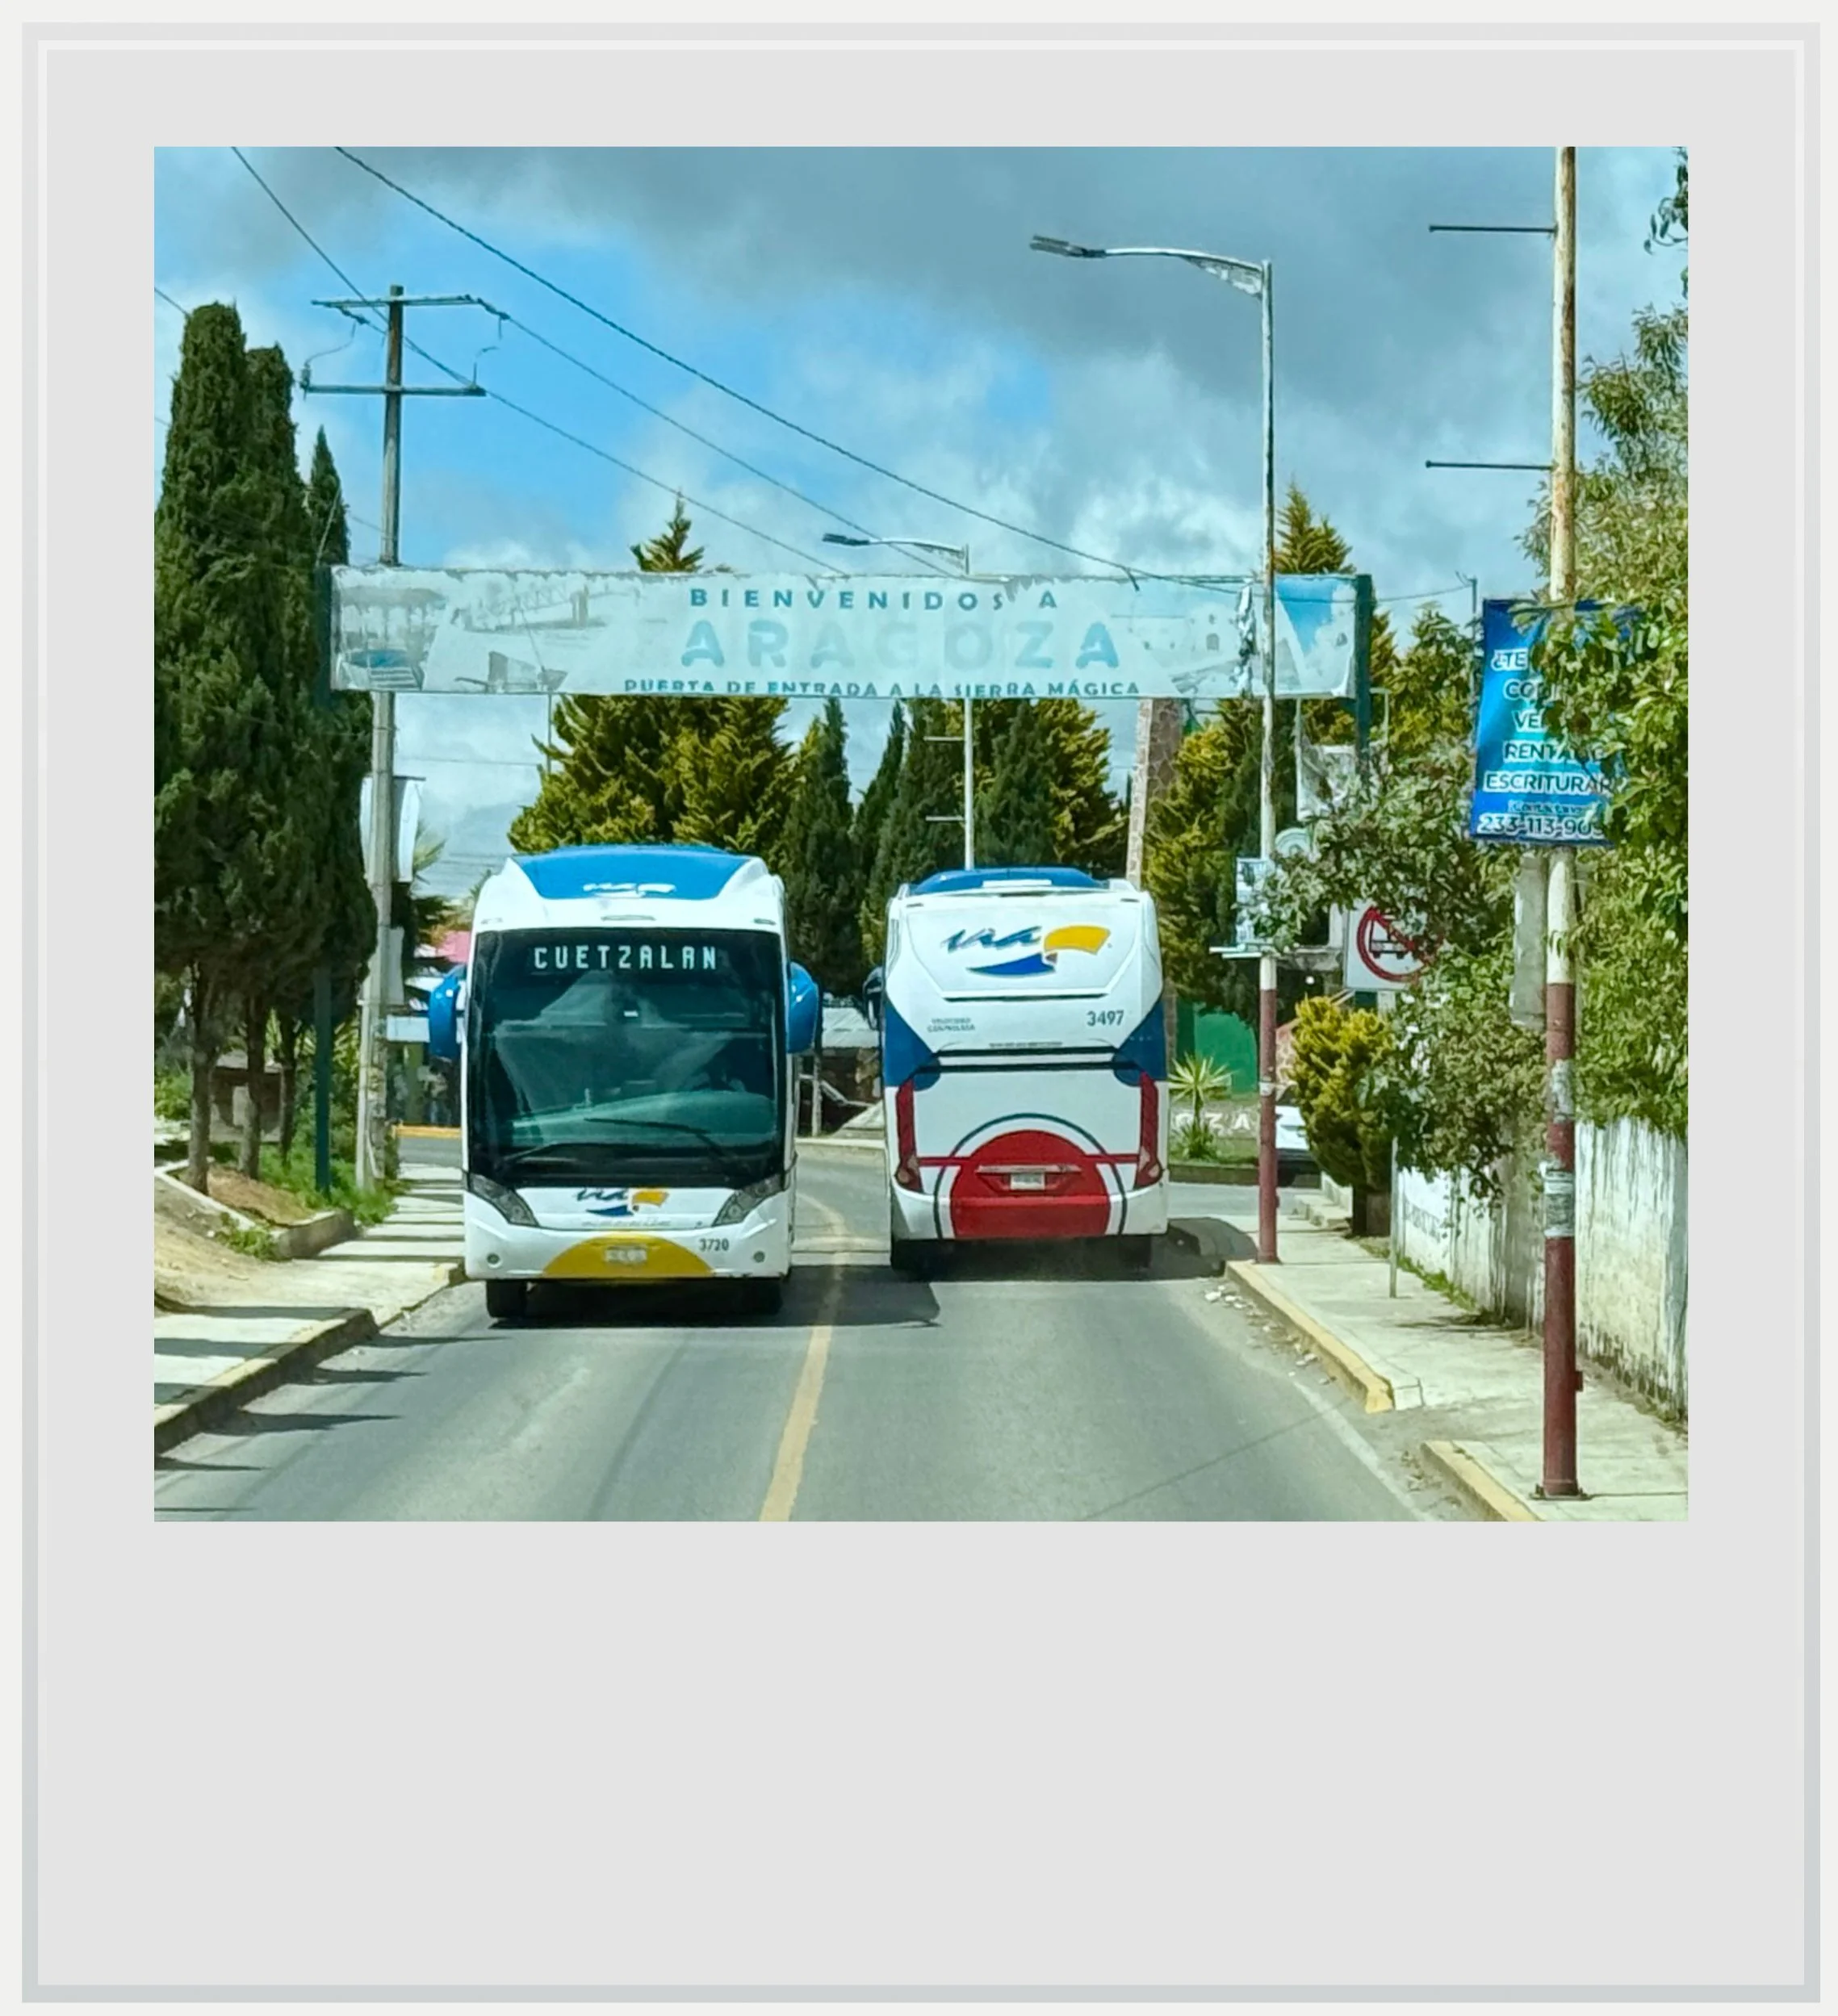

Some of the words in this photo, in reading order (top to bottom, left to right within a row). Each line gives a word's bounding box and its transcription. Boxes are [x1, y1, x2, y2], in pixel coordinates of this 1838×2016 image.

[690, 588, 1003, 611] BIENVENIDOS
[1038, 591, 1057, 609] A
[624, 679, 715, 692] PUERTA
[726, 680, 756, 694] DE
[767, 681, 879, 696] ENTRADA
[890, 682, 903, 696] A
[915, 683, 943, 697] LA
[954, 682, 1036, 698] SIERRA
[1048, 678, 1140, 696] MÁGICA
[534, 944, 717, 970] CUETZALAN
[1086, 1010, 1125, 1027] 3497
